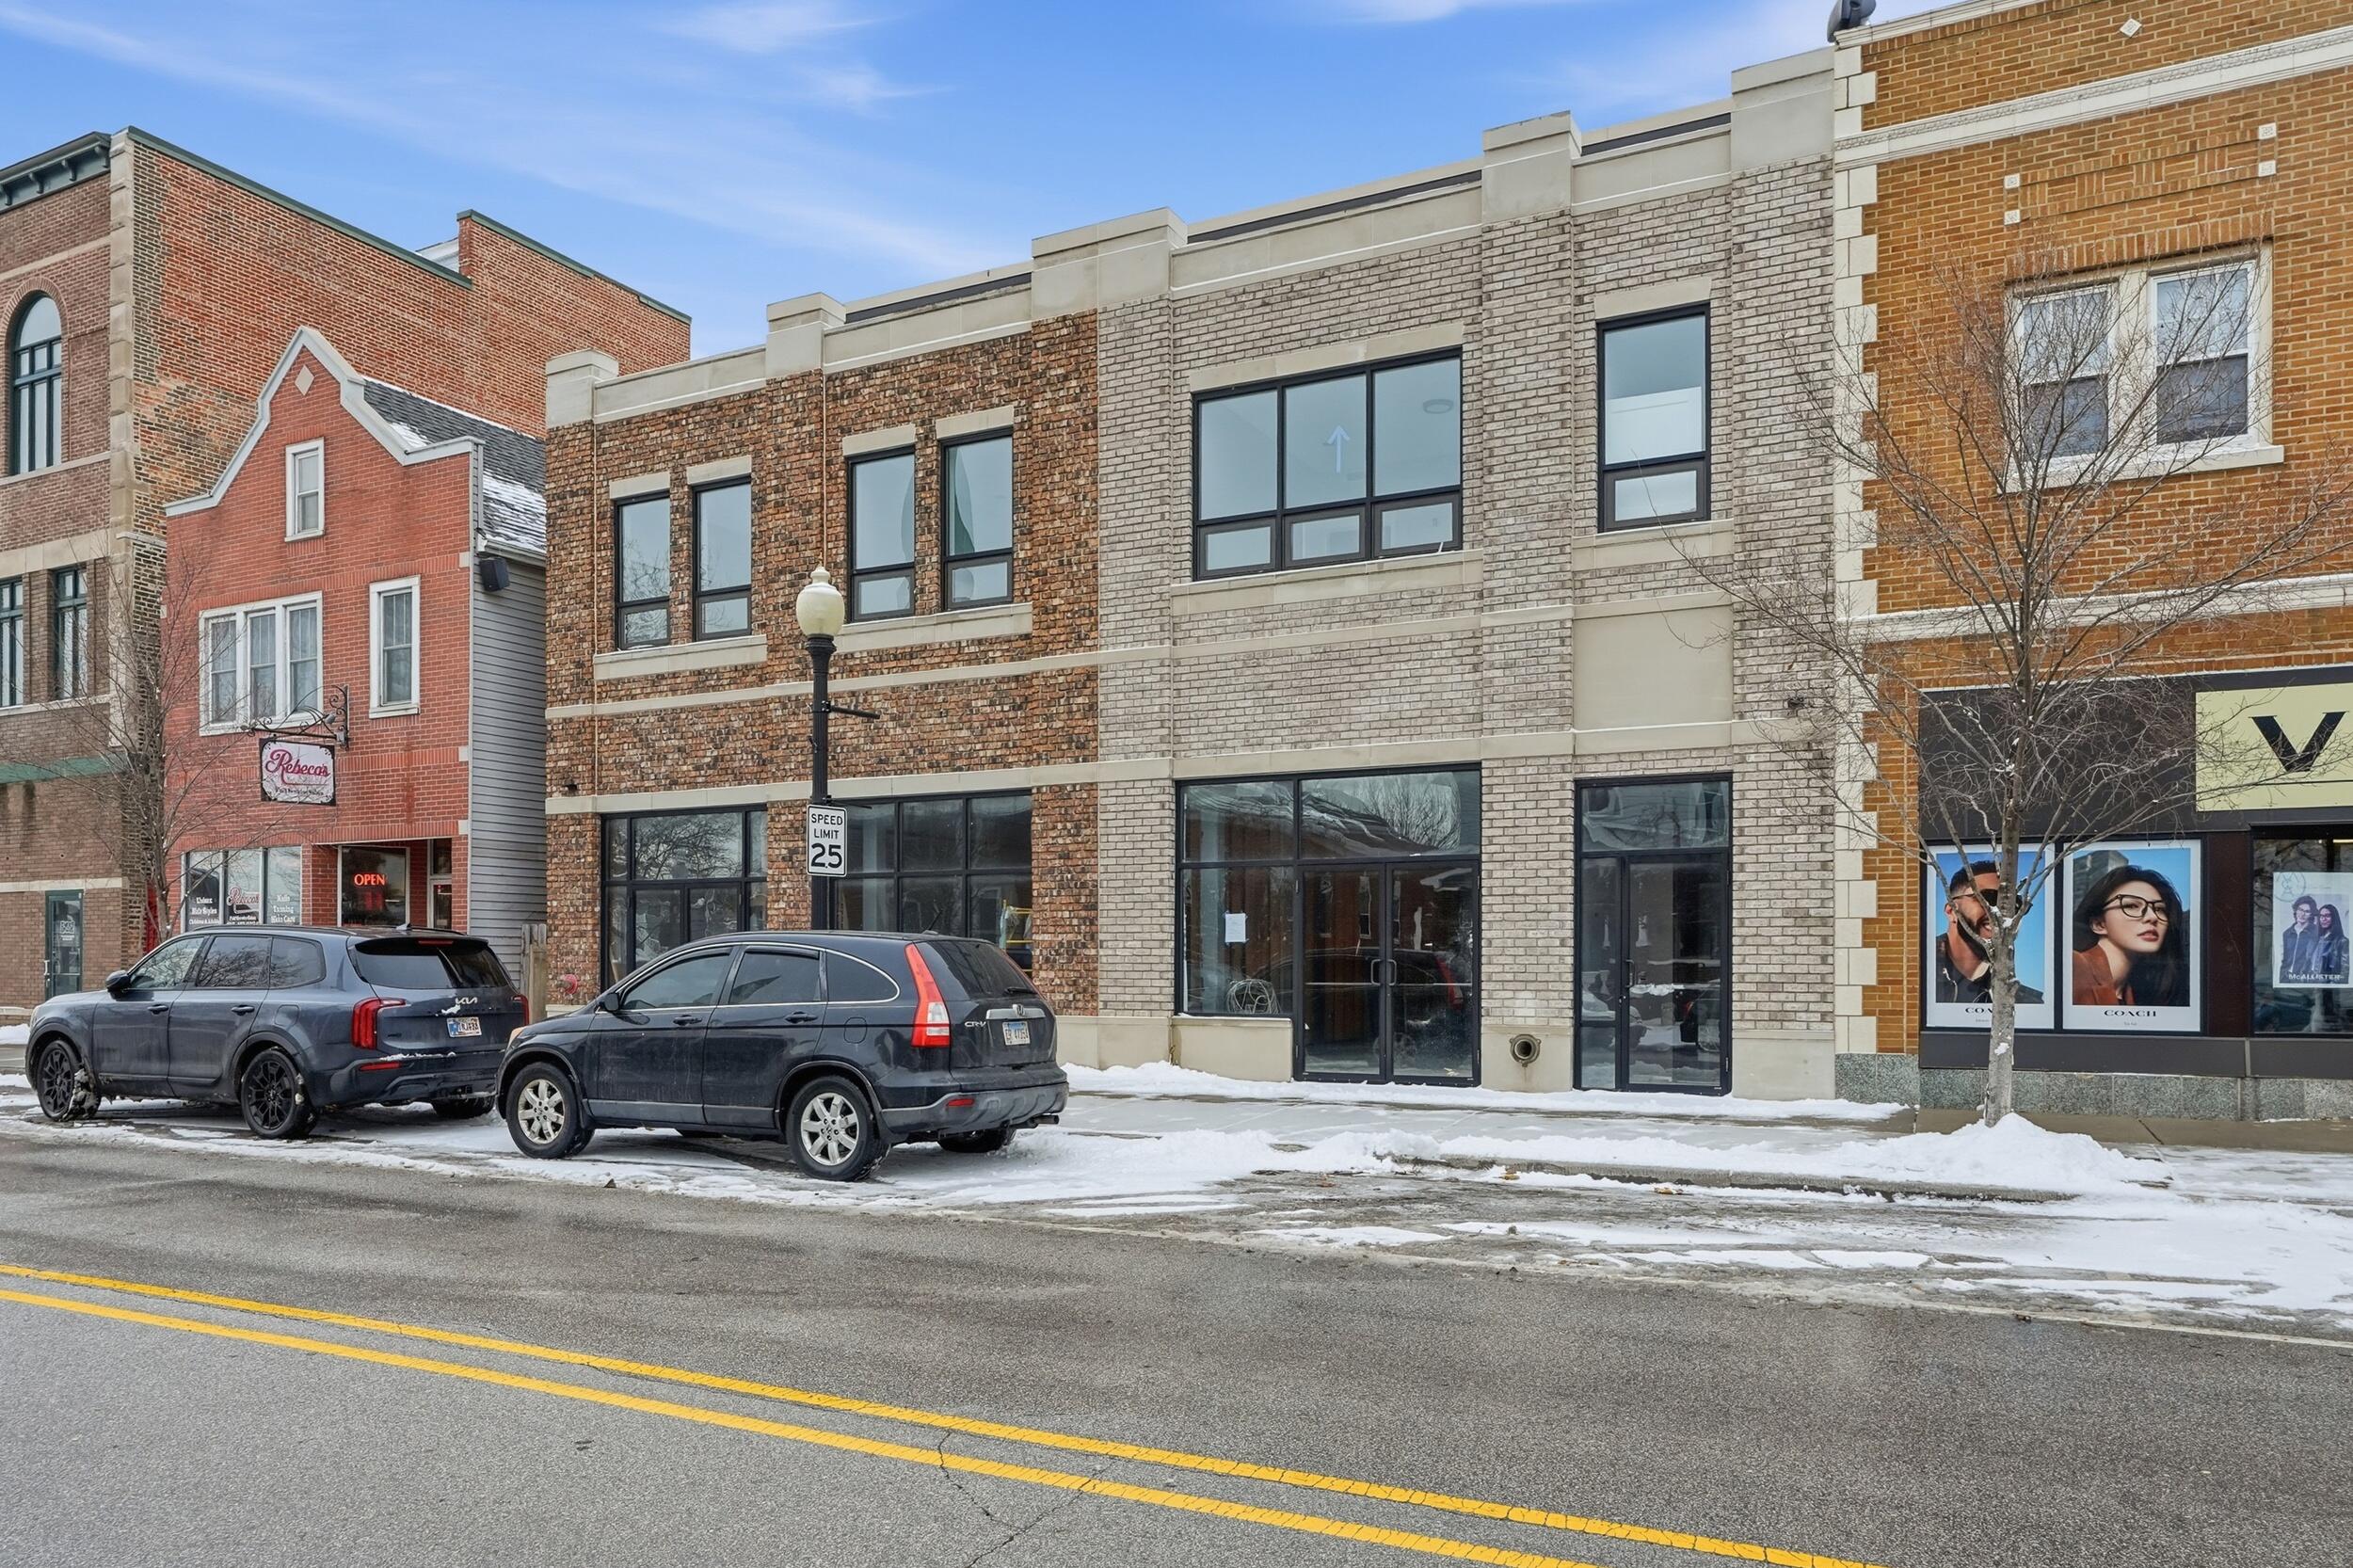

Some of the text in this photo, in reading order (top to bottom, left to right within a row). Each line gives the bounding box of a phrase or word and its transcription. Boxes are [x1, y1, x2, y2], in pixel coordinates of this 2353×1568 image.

[2249, 711, 2349, 772] V
[811, 813, 843, 825] SPEED
[814, 828, 840, 840] LIMIT
[811, 842, 842, 869] 25
[354, 873, 386, 886] OPEN
